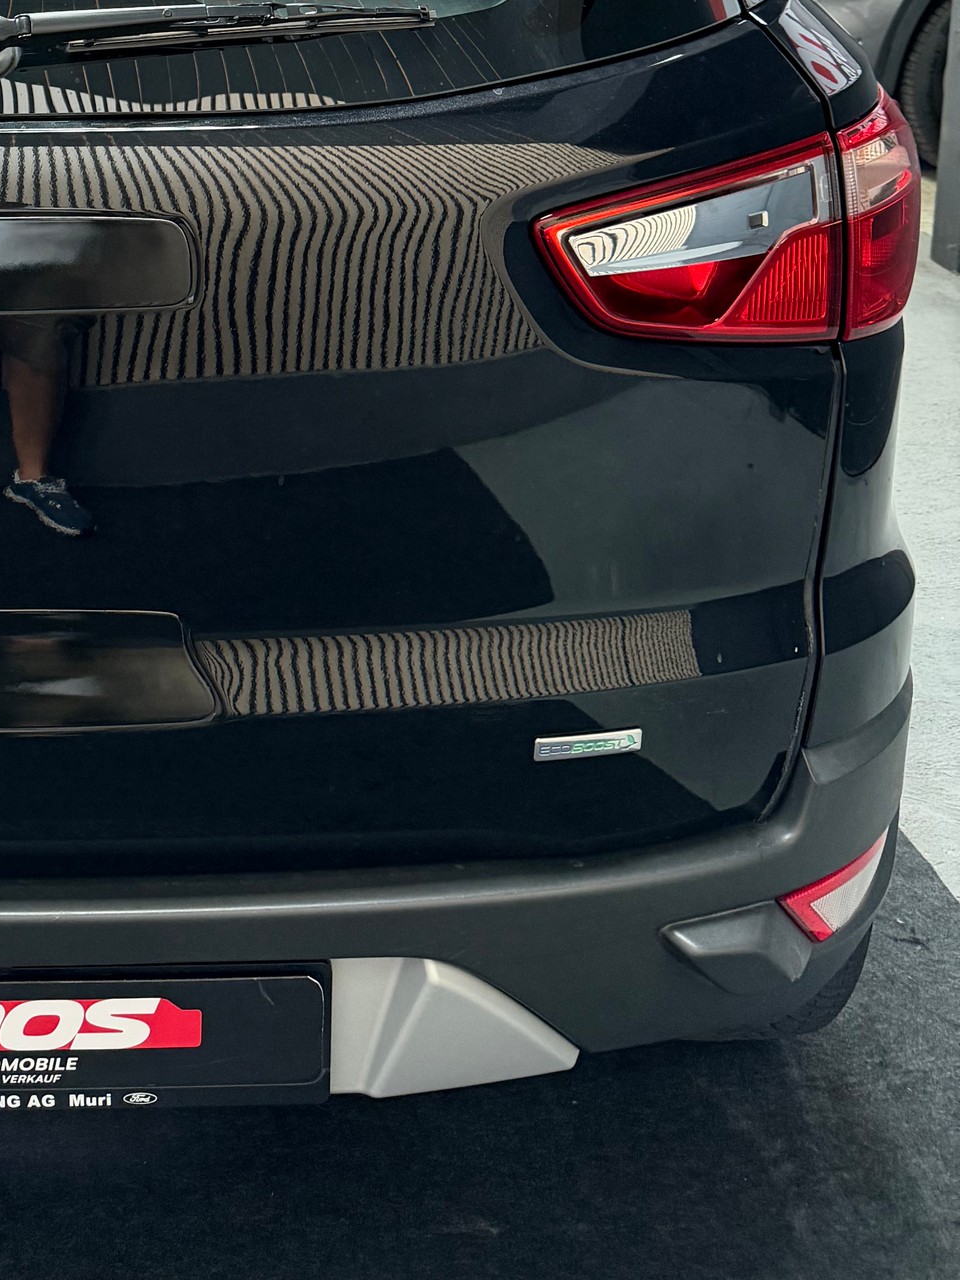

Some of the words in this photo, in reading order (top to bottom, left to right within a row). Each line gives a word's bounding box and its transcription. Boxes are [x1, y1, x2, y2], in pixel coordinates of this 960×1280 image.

[2, 1074, 62, 1084] VERKAUF
[27, 1094, 56, 1108] AG
[69, 1093, 112, 1107] Muri
